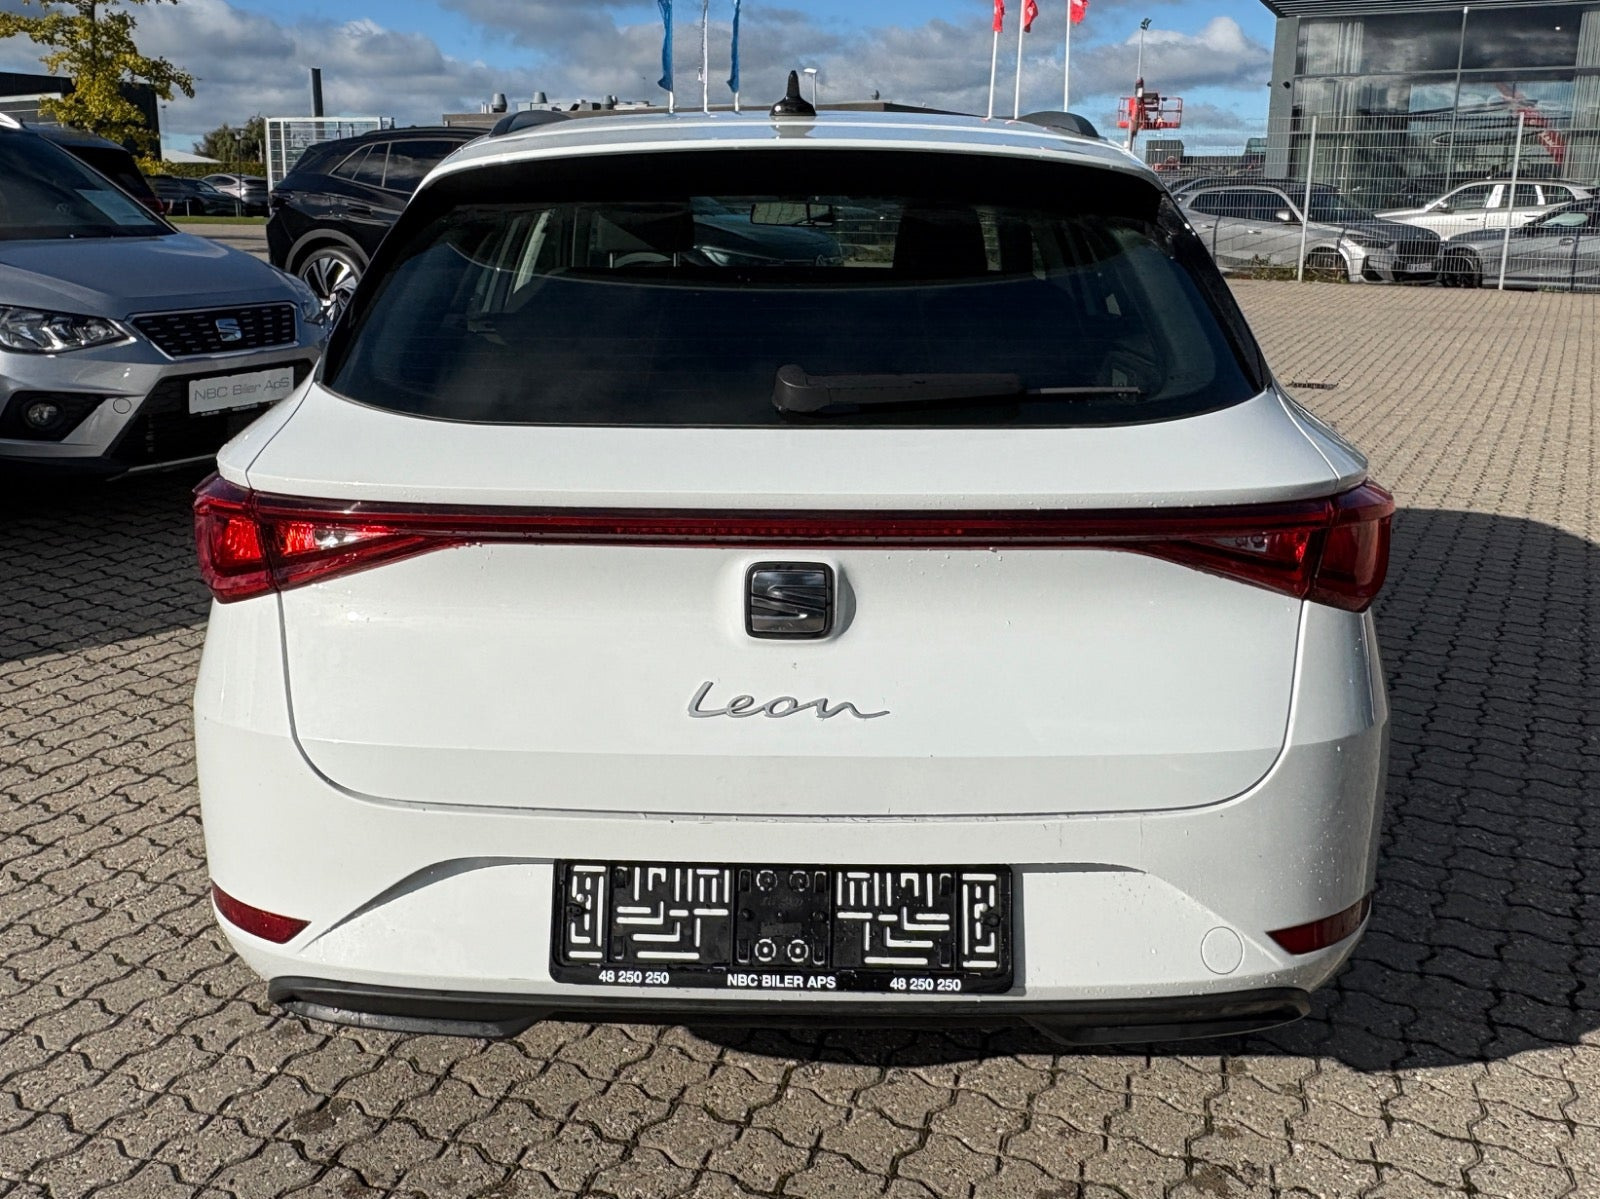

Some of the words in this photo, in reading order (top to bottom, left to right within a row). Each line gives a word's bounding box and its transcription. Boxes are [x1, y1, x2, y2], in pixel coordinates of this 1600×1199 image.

[194, 386, 228, 401] NBC
[263, 377, 290, 392] ApS
[688, 680, 890, 719] Leon
[598, 970, 615, 983] 48
[618, 970, 642, 984] 250
[645, 971, 670, 985] 250
[726, 973, 758, 987] NBC
[761, 974, 803, 988] BILER
[807, 975, 836, 989] APS
[889, 977, 907, 990] 48
[909, 978, 934, 991] 250
[936, 979, 962, 992] 250
